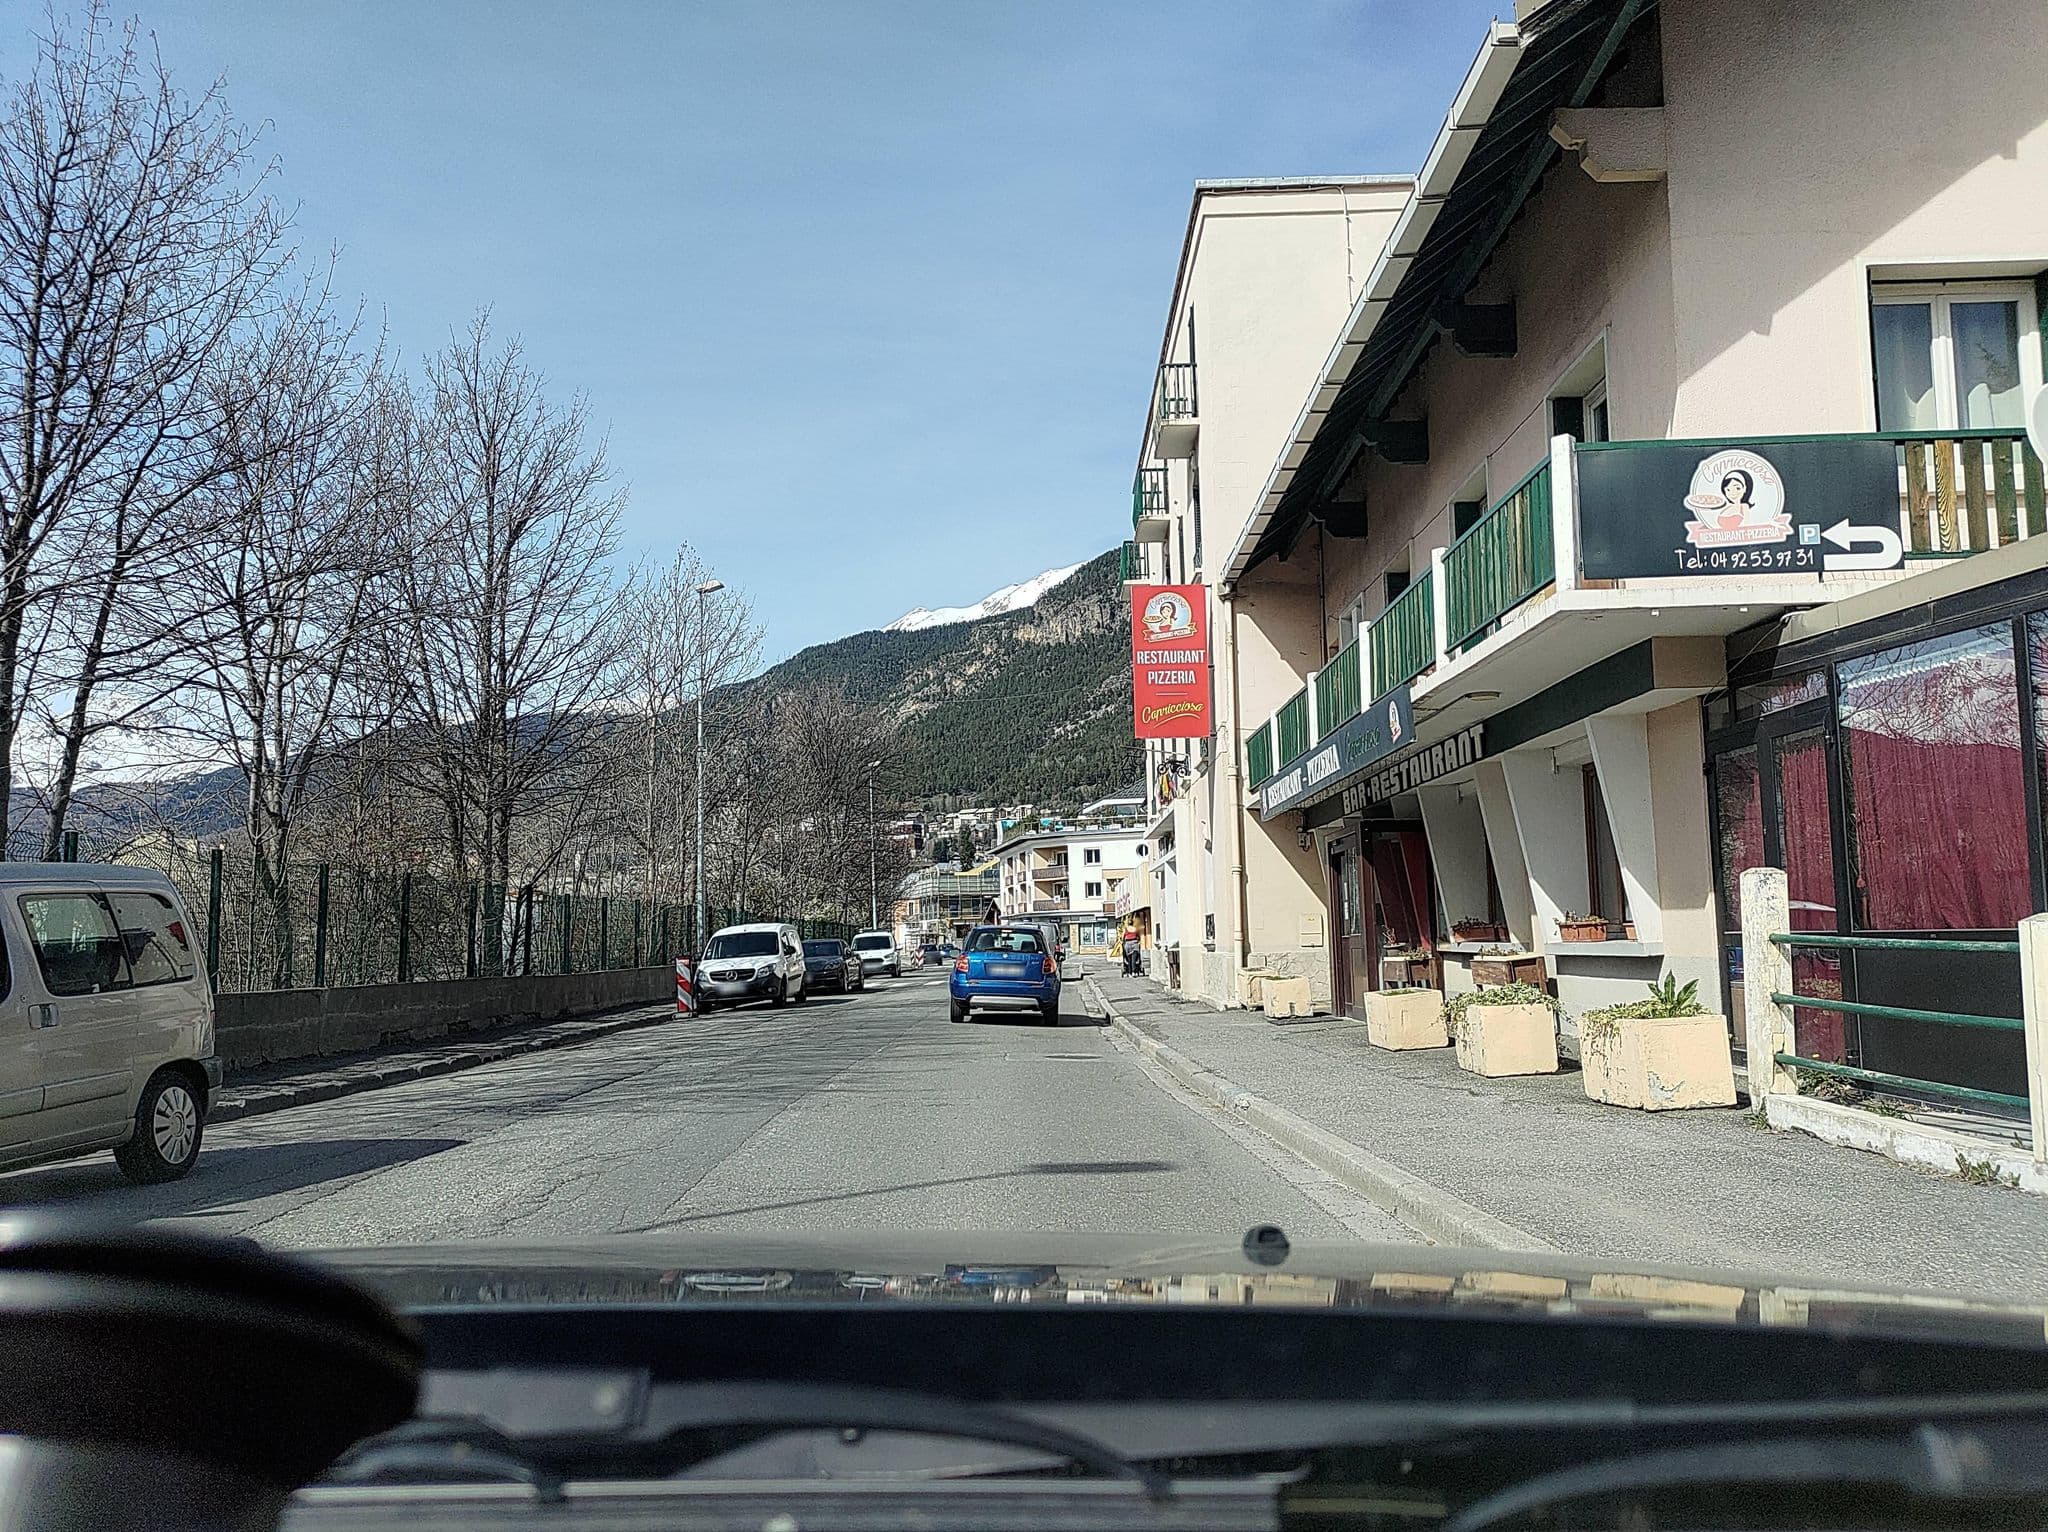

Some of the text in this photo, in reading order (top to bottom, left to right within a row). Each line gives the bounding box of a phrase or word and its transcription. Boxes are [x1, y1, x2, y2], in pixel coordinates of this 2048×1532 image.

[1674, 549, 1814, 569] Tel: 04 92 53 97 31
[1136, 650, 1206, 665] RESTAURANT
[1147, 670, 1196, 685] PIZZERIA
[1142, 701, 1204, 724] Capricciosa
